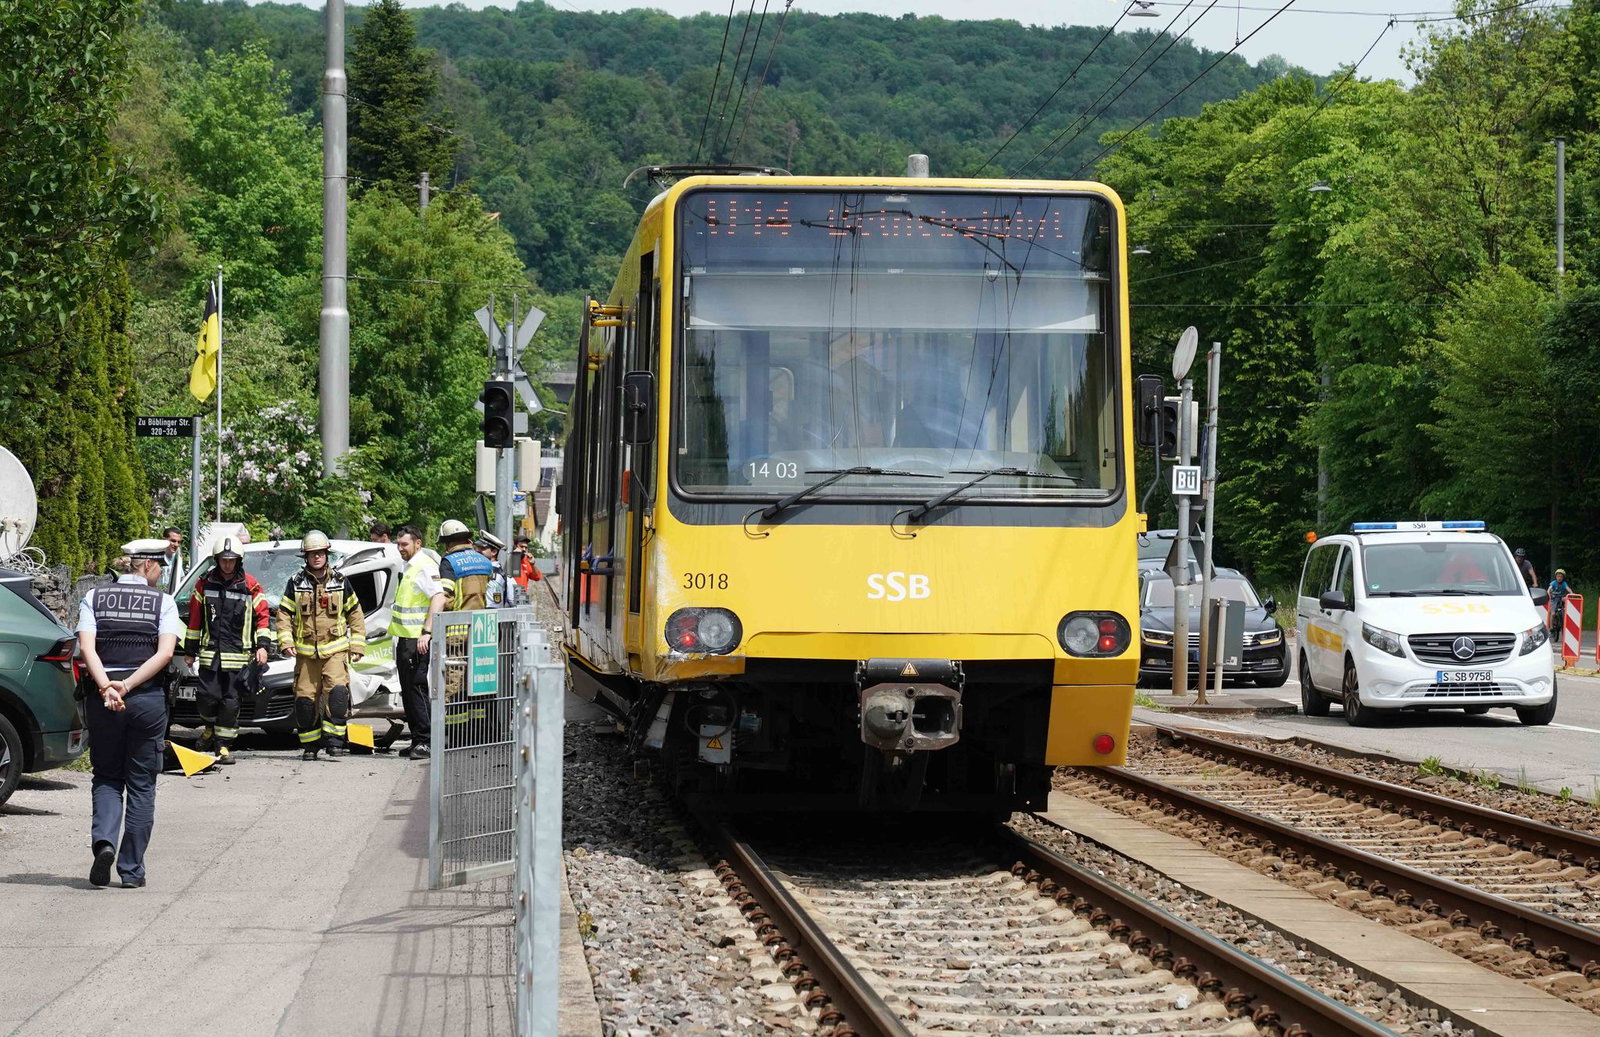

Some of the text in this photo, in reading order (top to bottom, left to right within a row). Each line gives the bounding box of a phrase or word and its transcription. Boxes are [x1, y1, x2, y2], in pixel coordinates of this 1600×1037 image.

[138, 417, 191, 428] Zu Böblinger Str.
[150, 427, 178, 436] 320-326
[749, 462, 798, 479] 14 03
[1178, 471, 1196, 489] Bü
[683, 572, 729, 590] 3018
[867, 571, 931, 602] SSB
[97, 594, 157, 612] POLIZEI
[1421, 601, 1492, 615] SSB
[1443, 671, 1491, 681] S SB 9758
